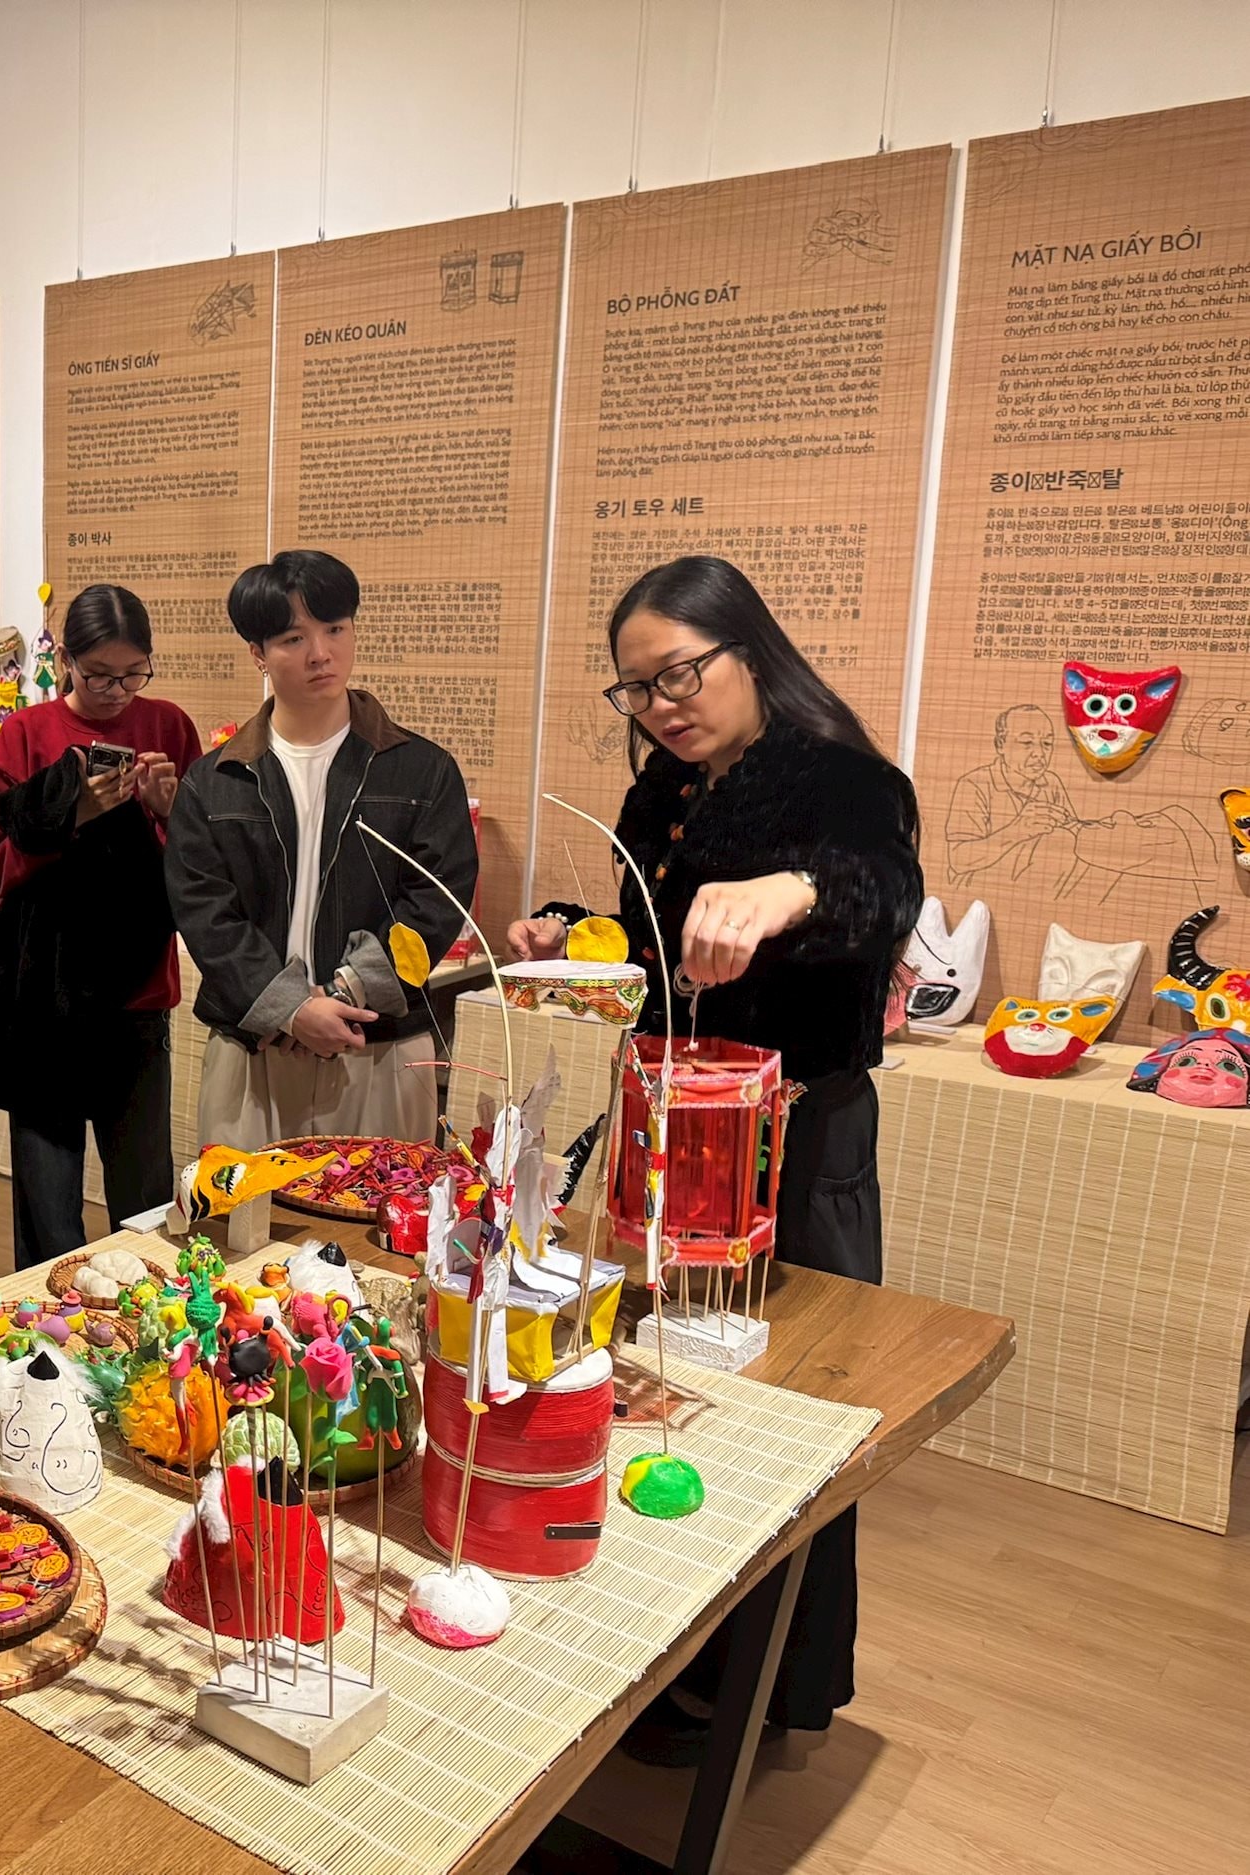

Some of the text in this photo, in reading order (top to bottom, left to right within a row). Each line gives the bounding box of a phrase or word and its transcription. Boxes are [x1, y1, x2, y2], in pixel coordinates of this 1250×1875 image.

[1011, 224, 1201, 270] MẶT NẠ GIẤY BỒI
[607, 280, 741, 317] BỘ PHỖNG ĐẤT
[305, 319, 406, 346] ĐÈN KÉO QUÂN
[68, 349, 160, 376] ÔNG TIẾN SĨ GIẤY
[594, 497, 704, 518] 옹기 토우 세트
[68, 531, 112, 547] 종이 박사
